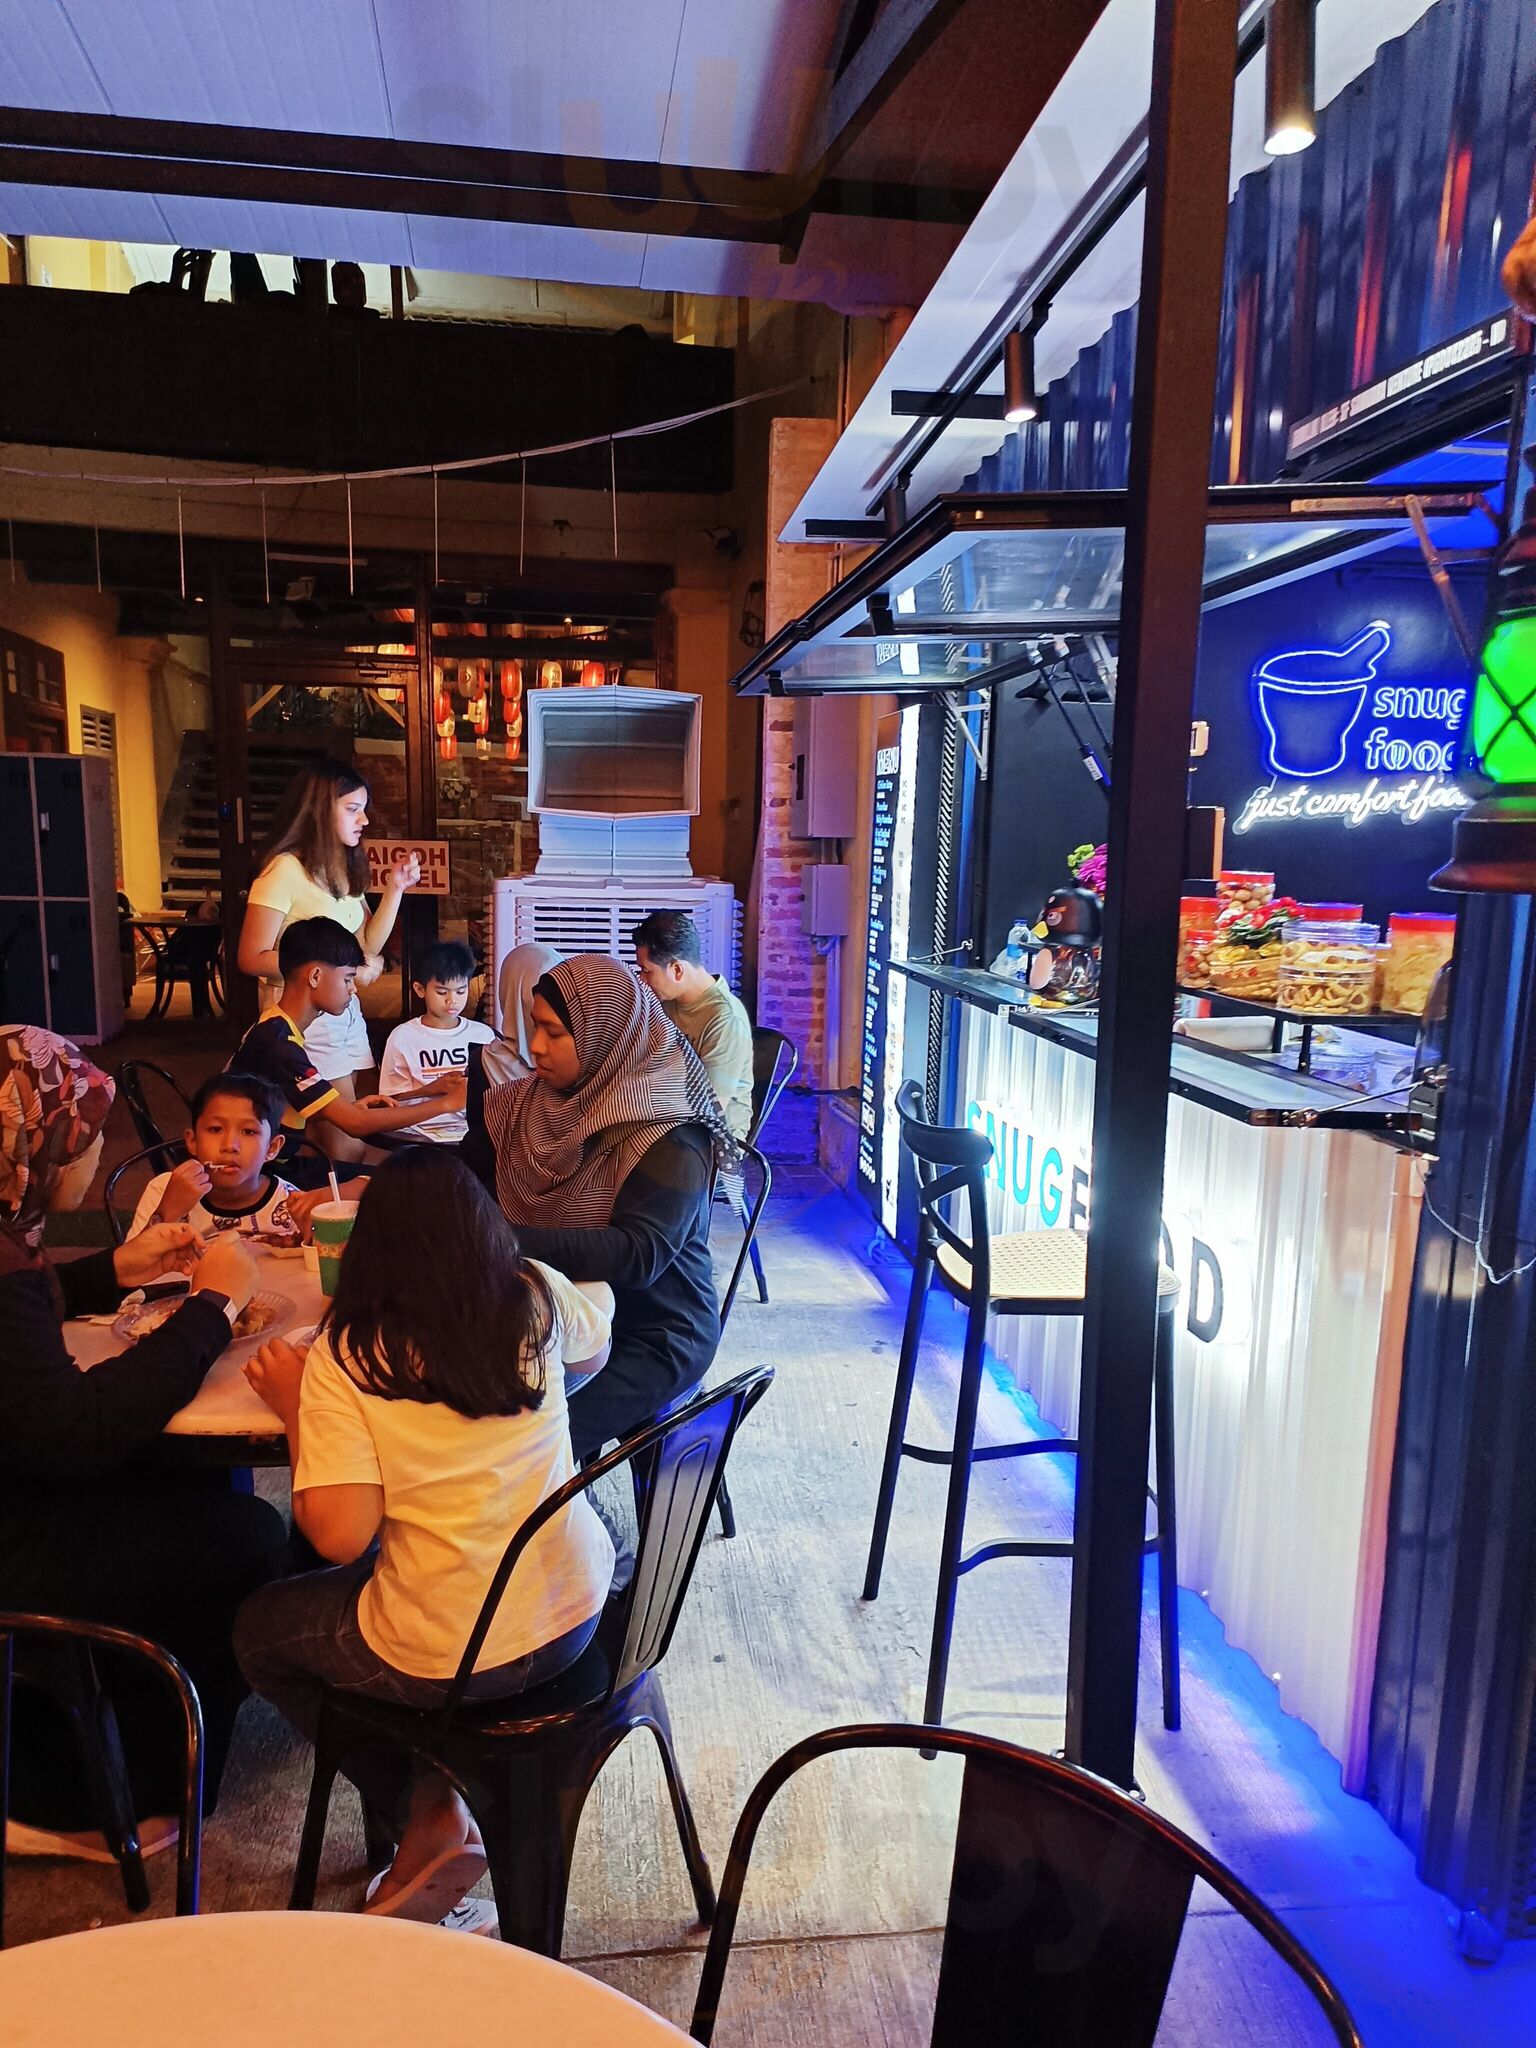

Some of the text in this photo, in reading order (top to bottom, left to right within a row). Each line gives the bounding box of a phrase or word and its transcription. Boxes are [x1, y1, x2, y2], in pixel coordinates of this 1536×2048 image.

[1236, 785, 1309, 831] just
[1306, 778, 1415, 824] comfort
[371, 868, 446, 889] OEL
[419, 1048, 467, 1068] NAS
